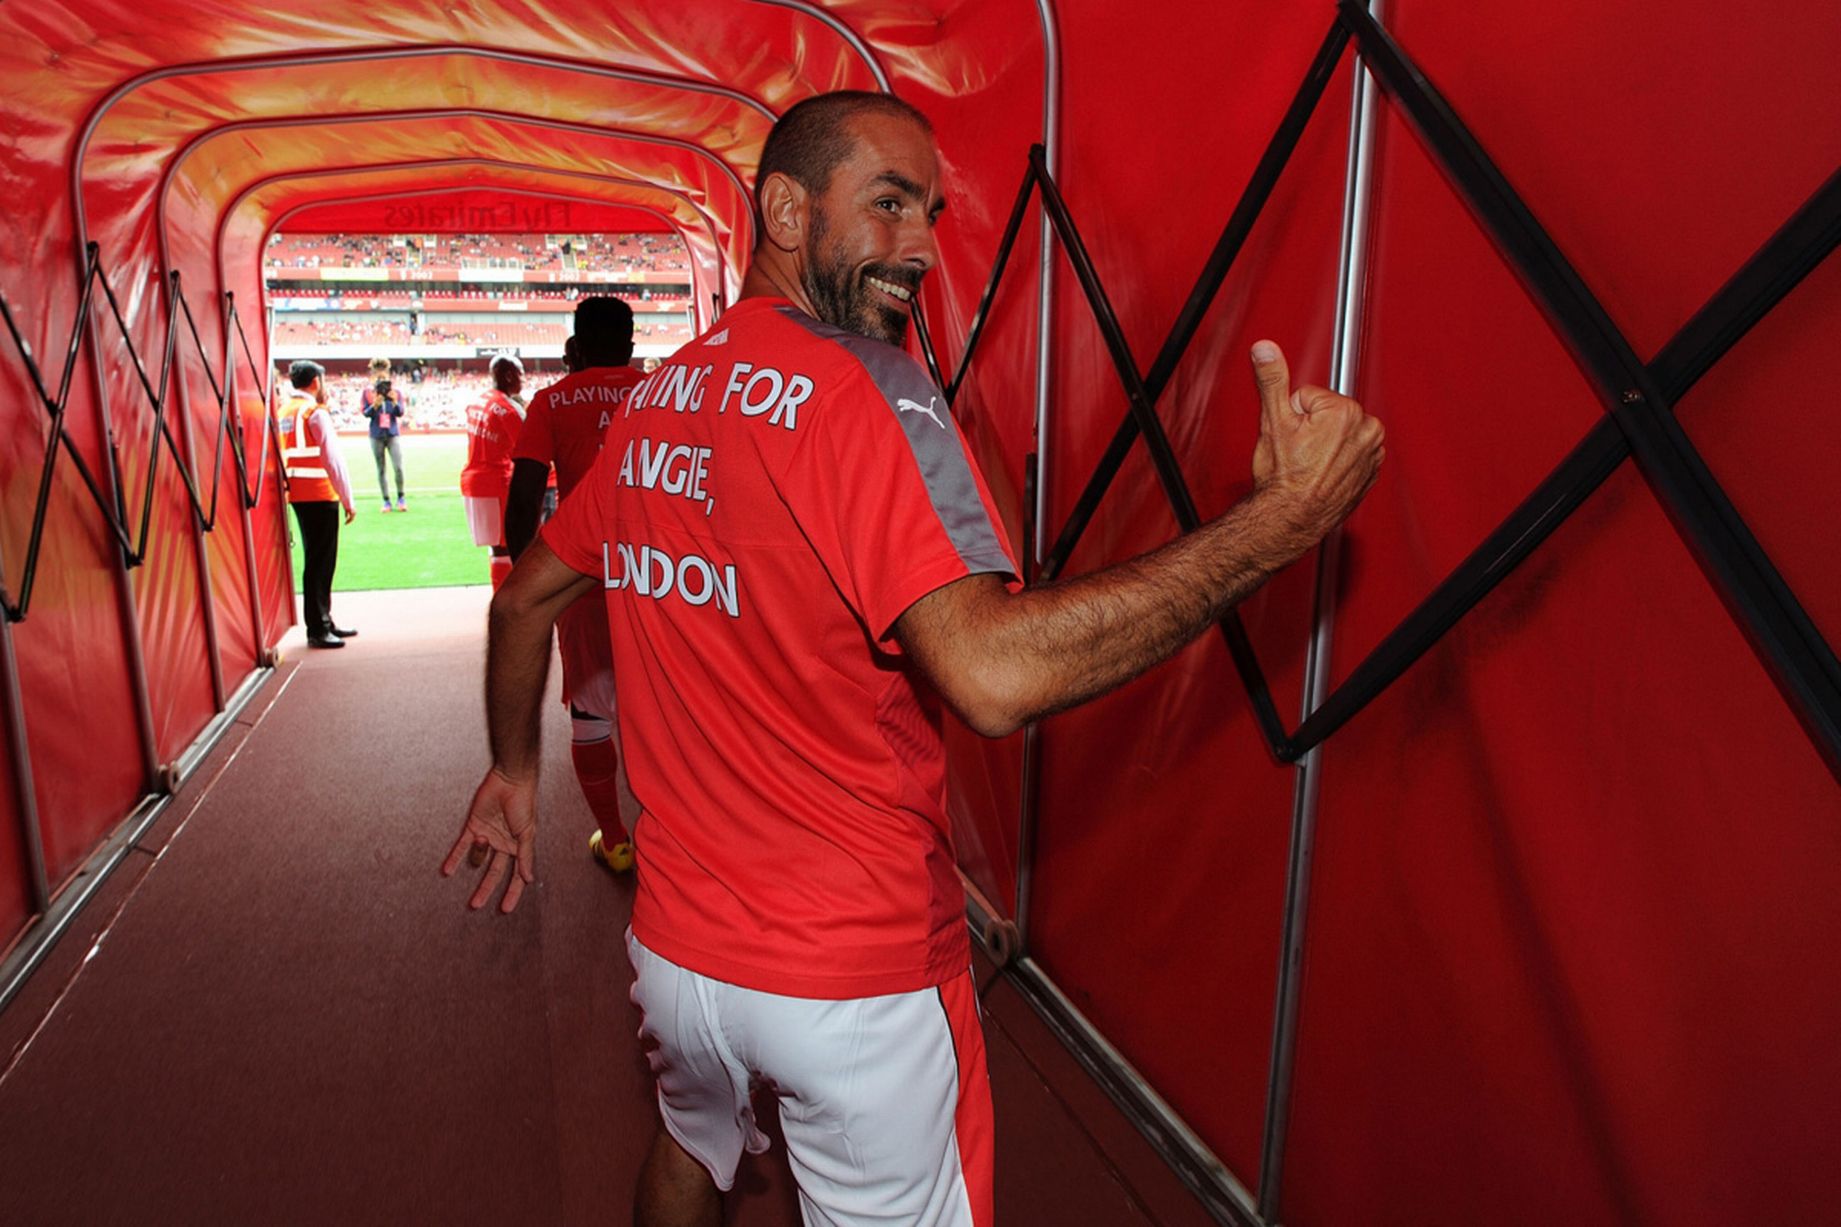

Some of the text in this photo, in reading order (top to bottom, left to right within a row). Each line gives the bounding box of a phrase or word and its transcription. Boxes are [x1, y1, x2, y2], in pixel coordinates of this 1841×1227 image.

[719, 361, 815, 430] FOR
[617, 438, 715, 517] ANGIE,
[602, 541, 740, 618] LONDON
